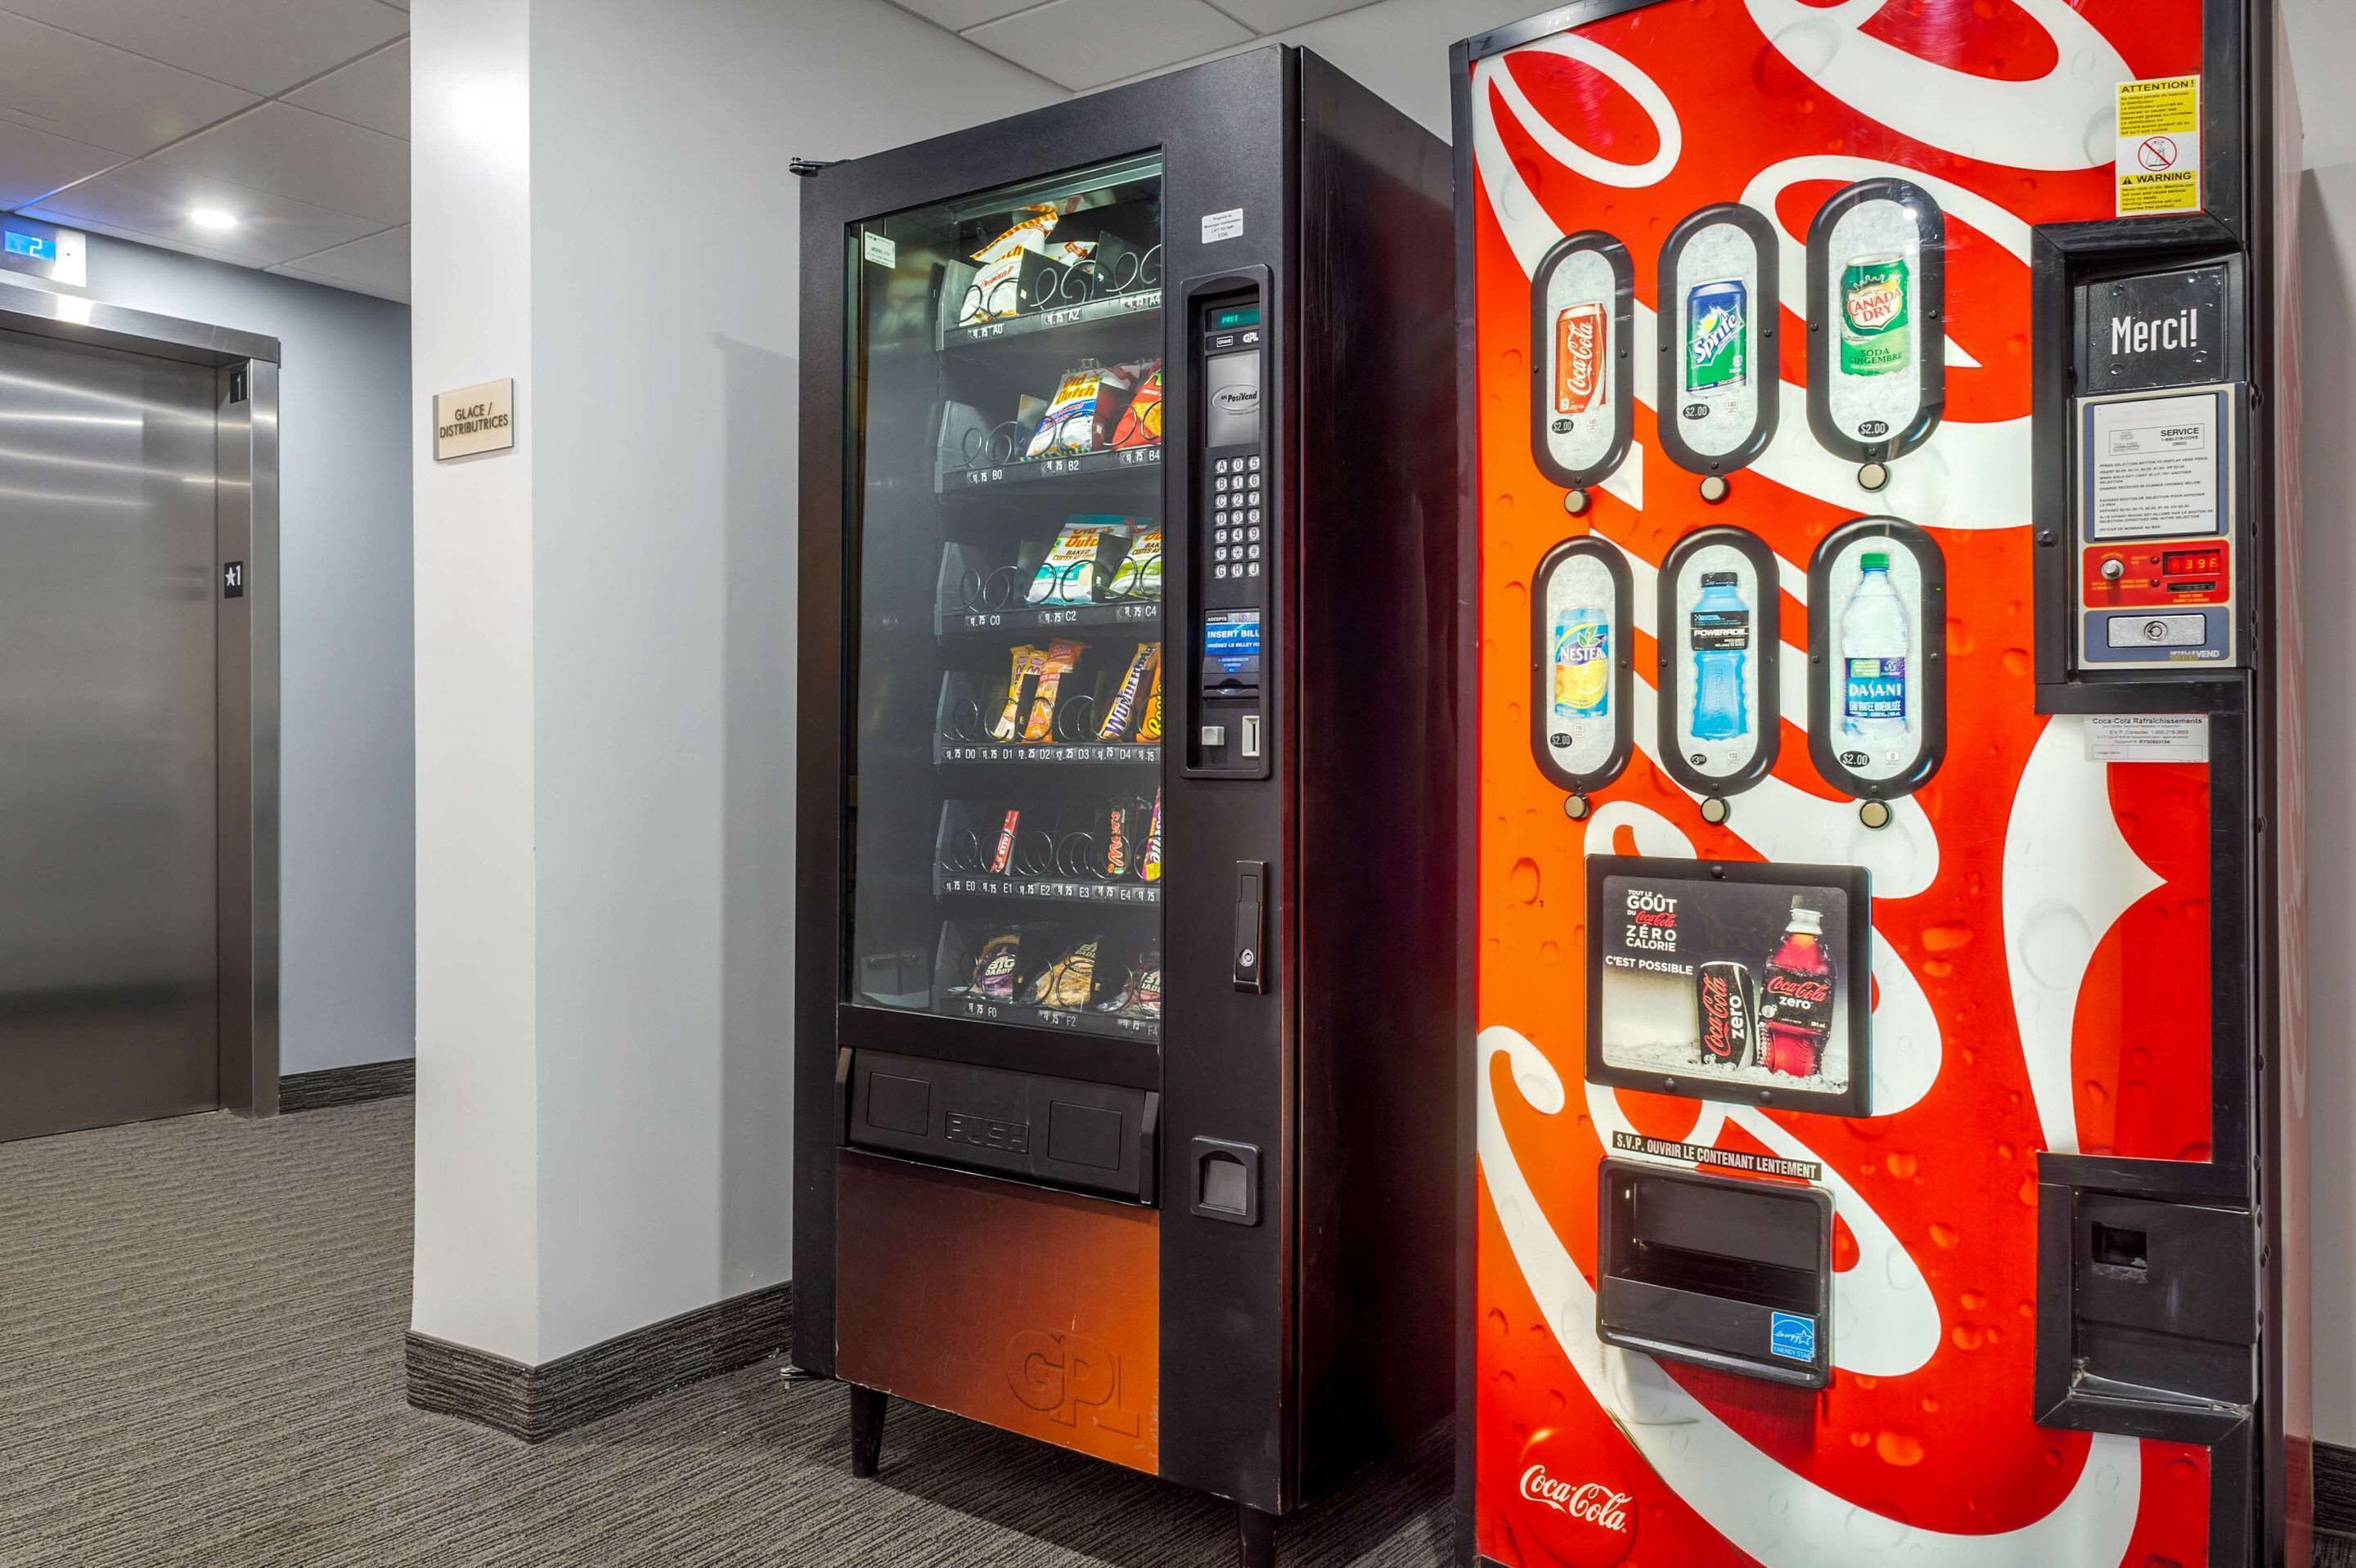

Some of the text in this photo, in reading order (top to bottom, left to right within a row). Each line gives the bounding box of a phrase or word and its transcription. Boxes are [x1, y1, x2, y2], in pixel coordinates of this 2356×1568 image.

[2121, 81, 2188, 93] ATTENTION
[2137, 172, 2192, 183] WARNING
[29, 236, 43, 258] 2
[1846, 290, 1901, 316] CANADA
[1068, 310, 1080, 321] A2
[1863, 304, 1891, 322] DRY
[992, 323, 1004, 335] A0
[2111, 308, 2197, 355] Merci!
[1243, 332, 1259, 344] GPL
[1693, 312, 1738, 365] Sprite
[1567, 320, 1594, 396] Coca-Cola
[1849, 352, 1903, 365] GINGEMBRE
[1860, 348, 1890, 357] SODA
[1054, 384, 1097, 406] Dutch
[454, 404, 485, 421] GLACE
[1685, 406, 1708, 418] $2.00
[439, 414, 509, 439] DISTRIBUTRICES
[1553, 420, 1572, 432] $2.00
[1859, 423, 1886, 435] $2.00
[2160, 427, 2200, 437] SERVICE
[1149, 449, 1160, 461] B4
[1068, 460, 1079, 471] B2
[991, 470, 1002, 480] B0
[1065, 535, 1099, 548] Dutc
[1065, 611, 1077, 622] C2
[1145, 605, 1156, 616] C4
[990, 615, 1000, 626] C0
[1207, 630, 1239, 638] INSERT
[1694, 628, 1746, 637] POWERADE
[1558, 647, 1607, 662] NESTEA
[1849, 681, 1902, 699] DASANI
[1551, 735, 1571, 745] $2.00
[965, 749, 976, 759] D0
[1003, 749, 1013, 759] D1
[1040, 749, 1050, 759] D2
[1078, 749, 1089, 760] D3
[1120, 749, 1131, 760] D4
[1842, 753, 1868, 766] $2.00
[966, 881, 975, 892] E0
[1004, 883, 1012, 893] E1
[1041, 884, 1050, 895] E2
[1079, 887, 1089, 897] E3
[1121, 889, 1131, 900] E4
[1626, 894, 1677, 913] GOÛT
[1635, 910, 1676, 928] Coca-Cola
[1626, 924, 1676, 941] ZÉRO
[1625, 938, 1676, 952] CALORIE
[1605, 955, 1693, 975] C'EST POSSIBLE
[985, 968, 1013, 976] DADDY
[1767, 976, 1831, 1002] Coca-Cola
[1778, 995, 1811, 1010] zero
[988, 1007, 997, 1018] F0
[1702, 973, 1731, 1057] Coca-Cola
[1729, 995, 1744, 1040] zero
[1066, 1017, 1076, 1027] F2
[1616, 1134, 1816, 1179] S.V.P. OUVRIR LE CONTENANT LENTEMENT
[1006, 1329, 1140, 1439] GPL
[1519, 1464, 1633, 1531] Coca-Cola
